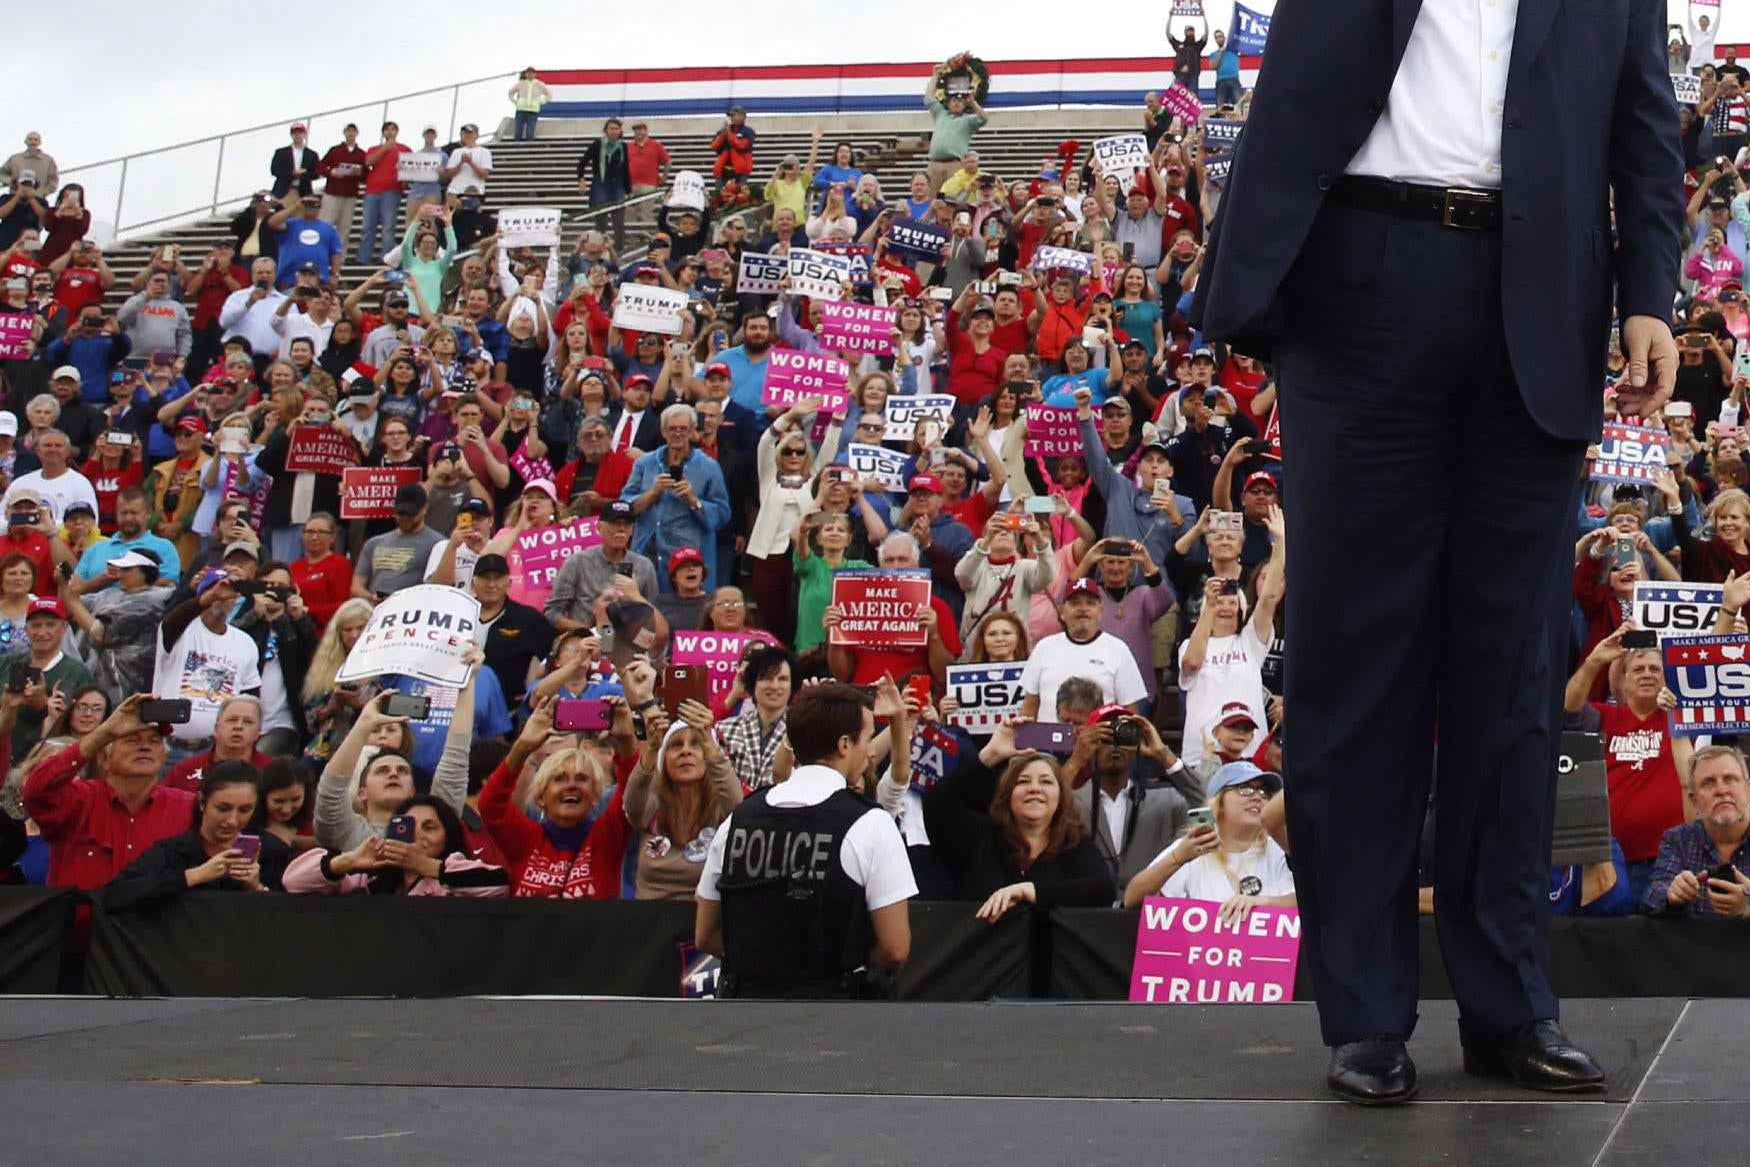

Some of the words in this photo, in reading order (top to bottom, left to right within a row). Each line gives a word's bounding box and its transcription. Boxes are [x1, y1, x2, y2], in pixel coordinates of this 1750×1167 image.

[1100, 144, 1144, 158] USA
[893, 225, 944, 245] TRUMP
[791, 261, 839, 280] USA
[825, 303, 896, 321] WOMEN
[825, 335, 888, 351] TRUMP
[771, 352, 849, 376] WOMEN
[1028, 407, 1103, 422] WOMN
[1599, 440, 1667, 461] USA
[856, 456, 904, 474] US
[841, 620, 882, 633] GREAT
[885, 619, 918, 632] AGAIN
[678, 637, 744, 653] WOM
[956, 685, 1027, 707] USA
[728, 829, 832, 879] POLICE
[1189, 947, 1242, 967] FOR
[1142, 976, 1283, 1001] TRUMP
